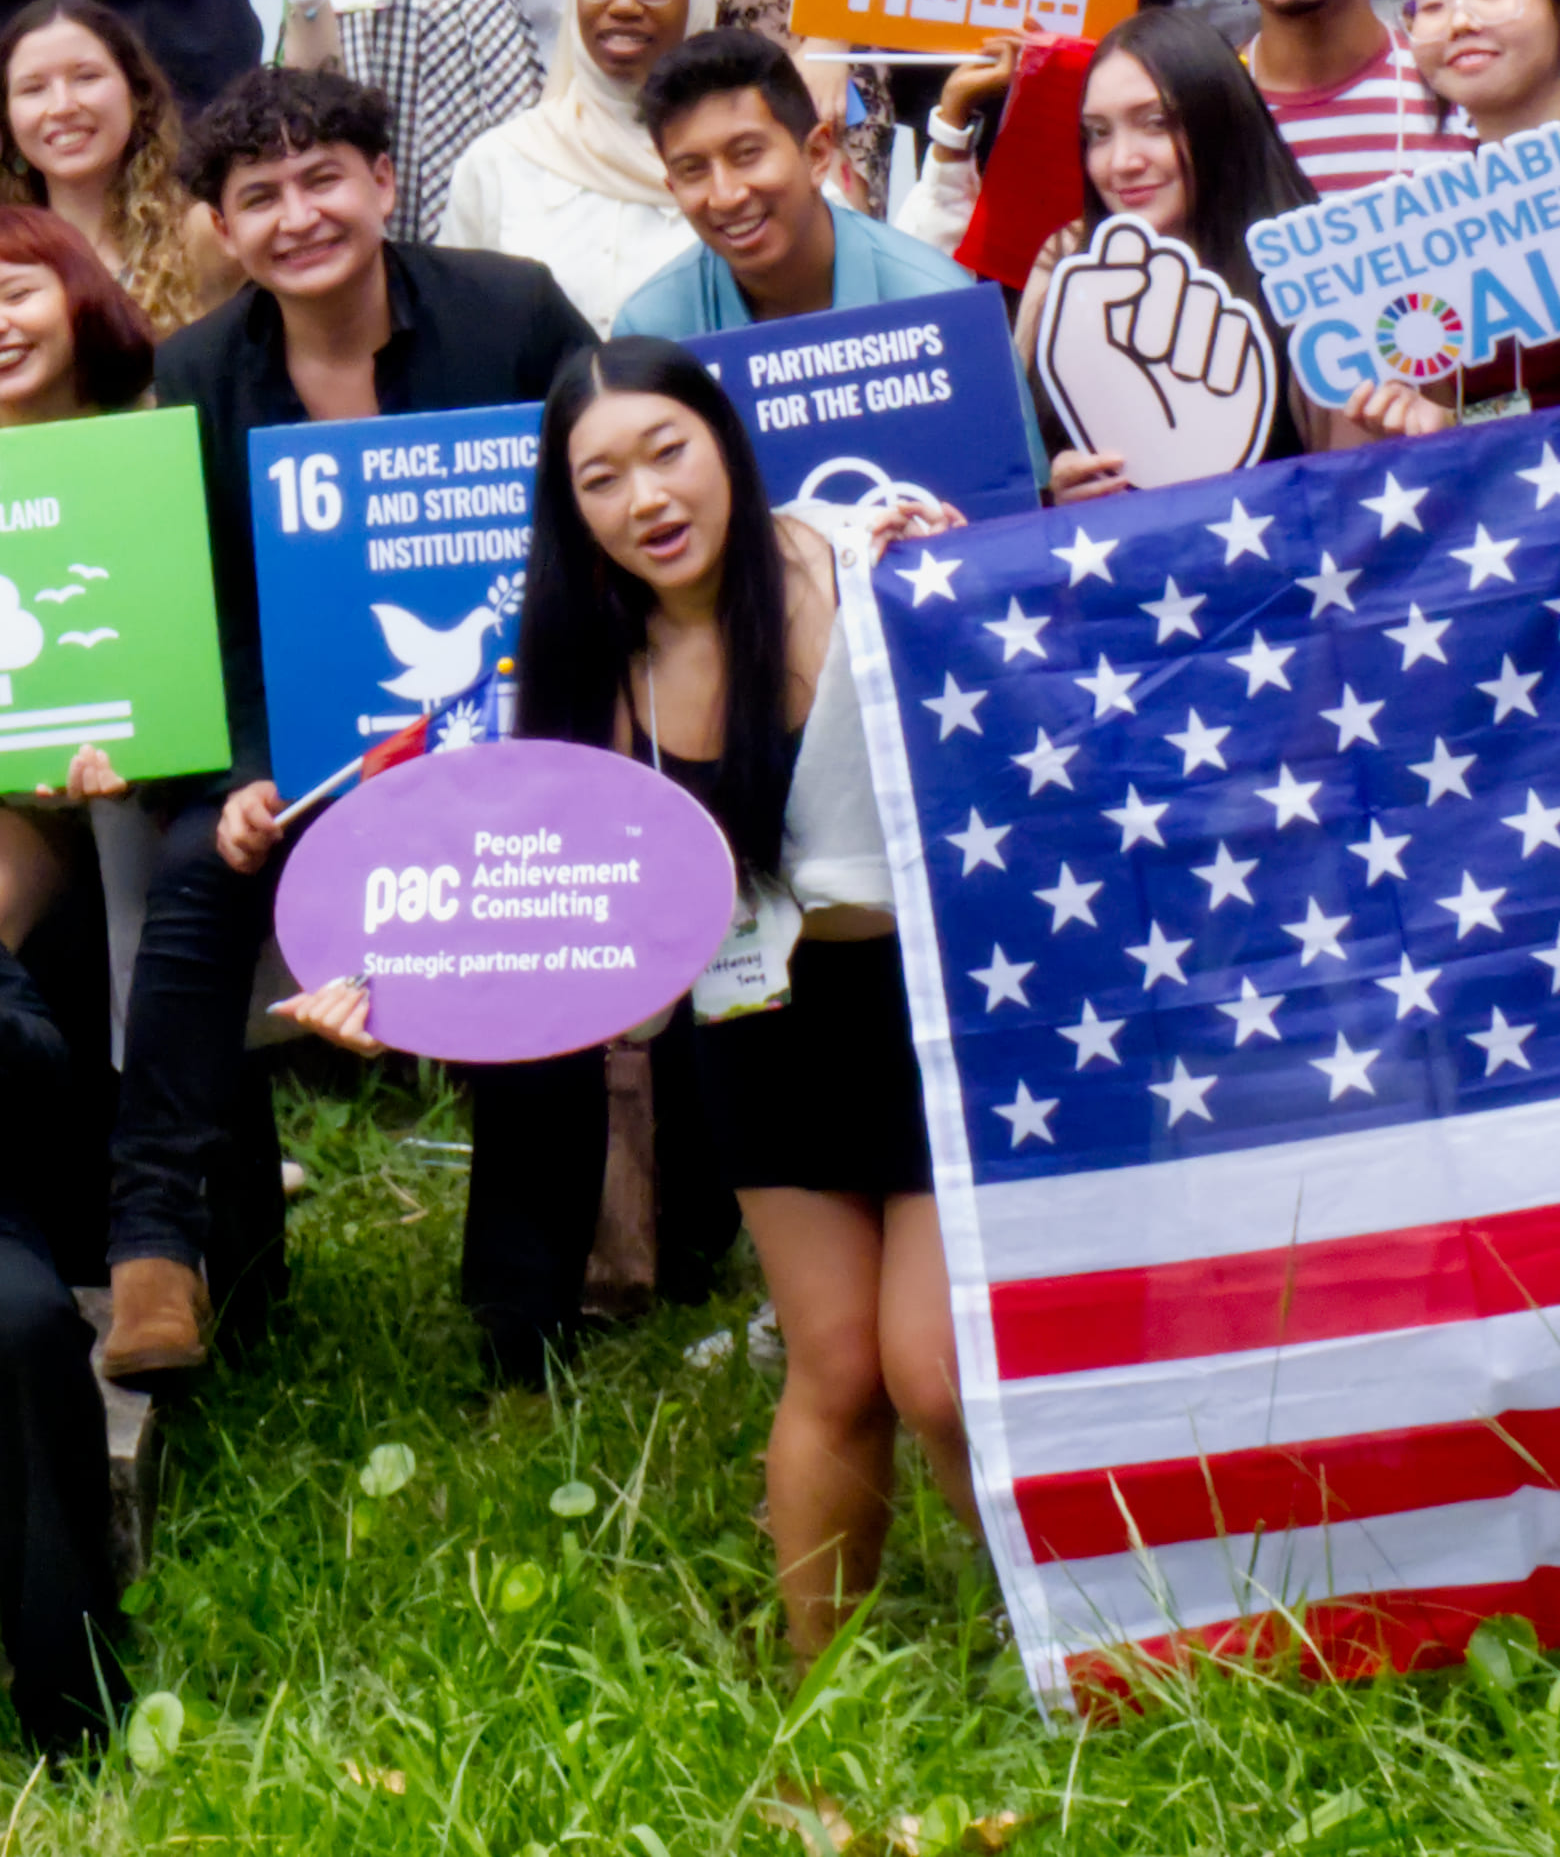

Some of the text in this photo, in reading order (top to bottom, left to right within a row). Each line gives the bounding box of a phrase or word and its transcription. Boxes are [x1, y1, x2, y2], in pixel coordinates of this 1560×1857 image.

[748, 324, 945, 388] PARTNERSHIPS
[756, 369, 953, 433] FOR THE GOALS
[362, 435, 541, 482] PEACE, JUSTIC
[268, 453, 343, 534] 16
[366, 482, 526, 526] AND STRONG
[474, 827, 562, 861] People
[472, 858, 640, 889] Achievement
[363, 864, 461, 935] pac
[471, 891, 609, 923] Consulting
[362, 946, 637, 980] Strategic partner of NCDA
